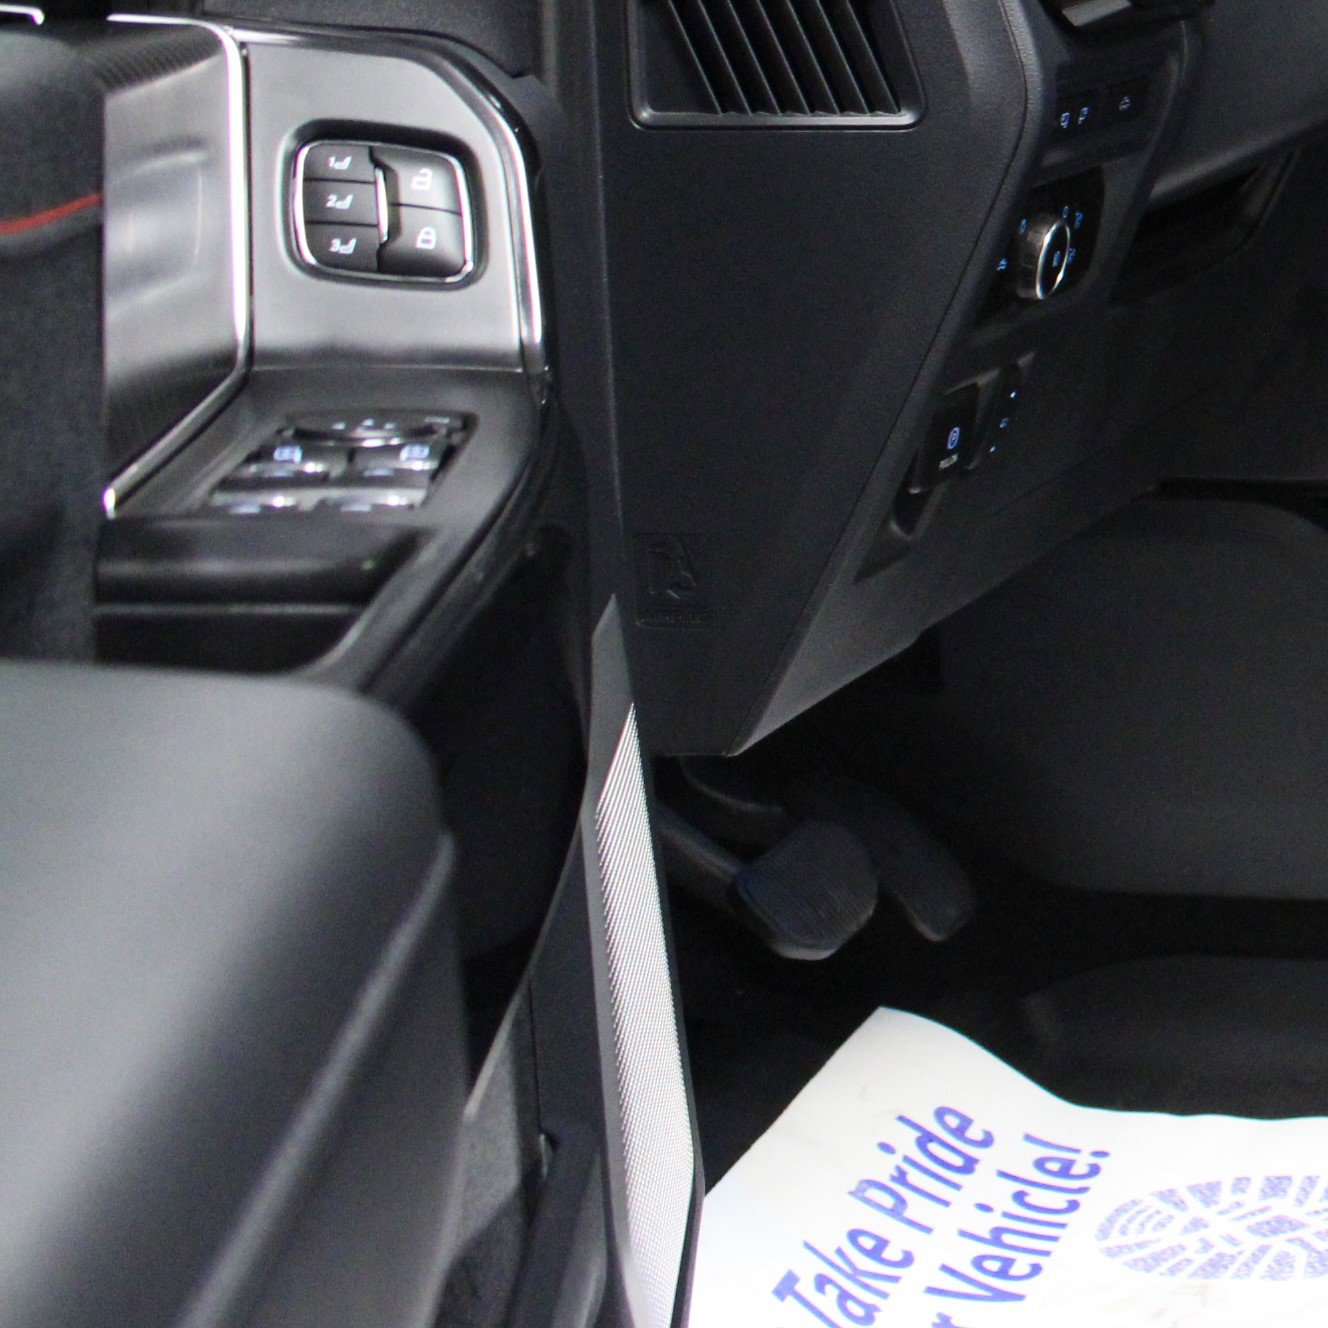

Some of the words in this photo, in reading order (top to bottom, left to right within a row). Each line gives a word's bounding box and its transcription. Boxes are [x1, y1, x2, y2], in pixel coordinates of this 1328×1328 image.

[771, 1228, 915, 1328] Take
[847, 1105, 995, 1235] Pride
[923, 1131, 1111, 1303] Vehicle!
